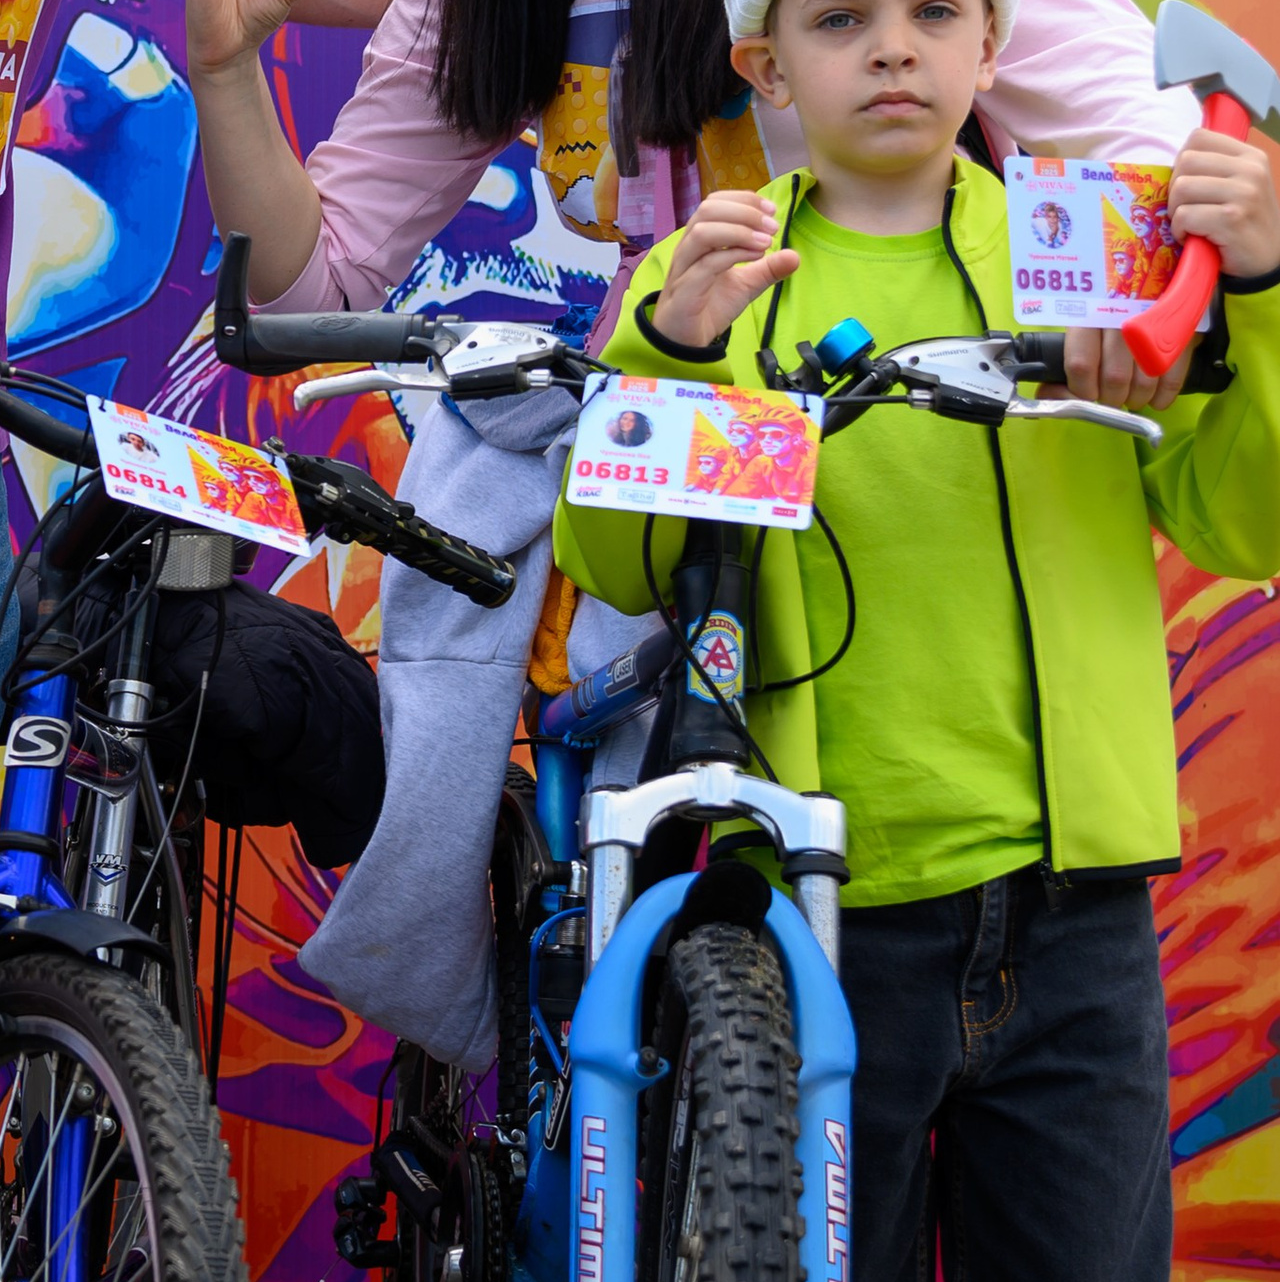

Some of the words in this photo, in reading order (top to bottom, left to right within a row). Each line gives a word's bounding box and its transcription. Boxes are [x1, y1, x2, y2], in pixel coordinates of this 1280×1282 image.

[1081, 168, 1153, 183] ВелоСемья
[1039, 181, 1064, 190] VIVA
[1016, 268, 1093, 293] 06815
[927, 348, 969, 358] SHIMANO
[623, 394, 651, 403] VIVA
[675, 387, 762, 405] ВелоСемья
[164, 424, 237, 453] ВелоСемья
[107, 464, 187, 498] 06814
[576, 460, 669, 485] 06813
